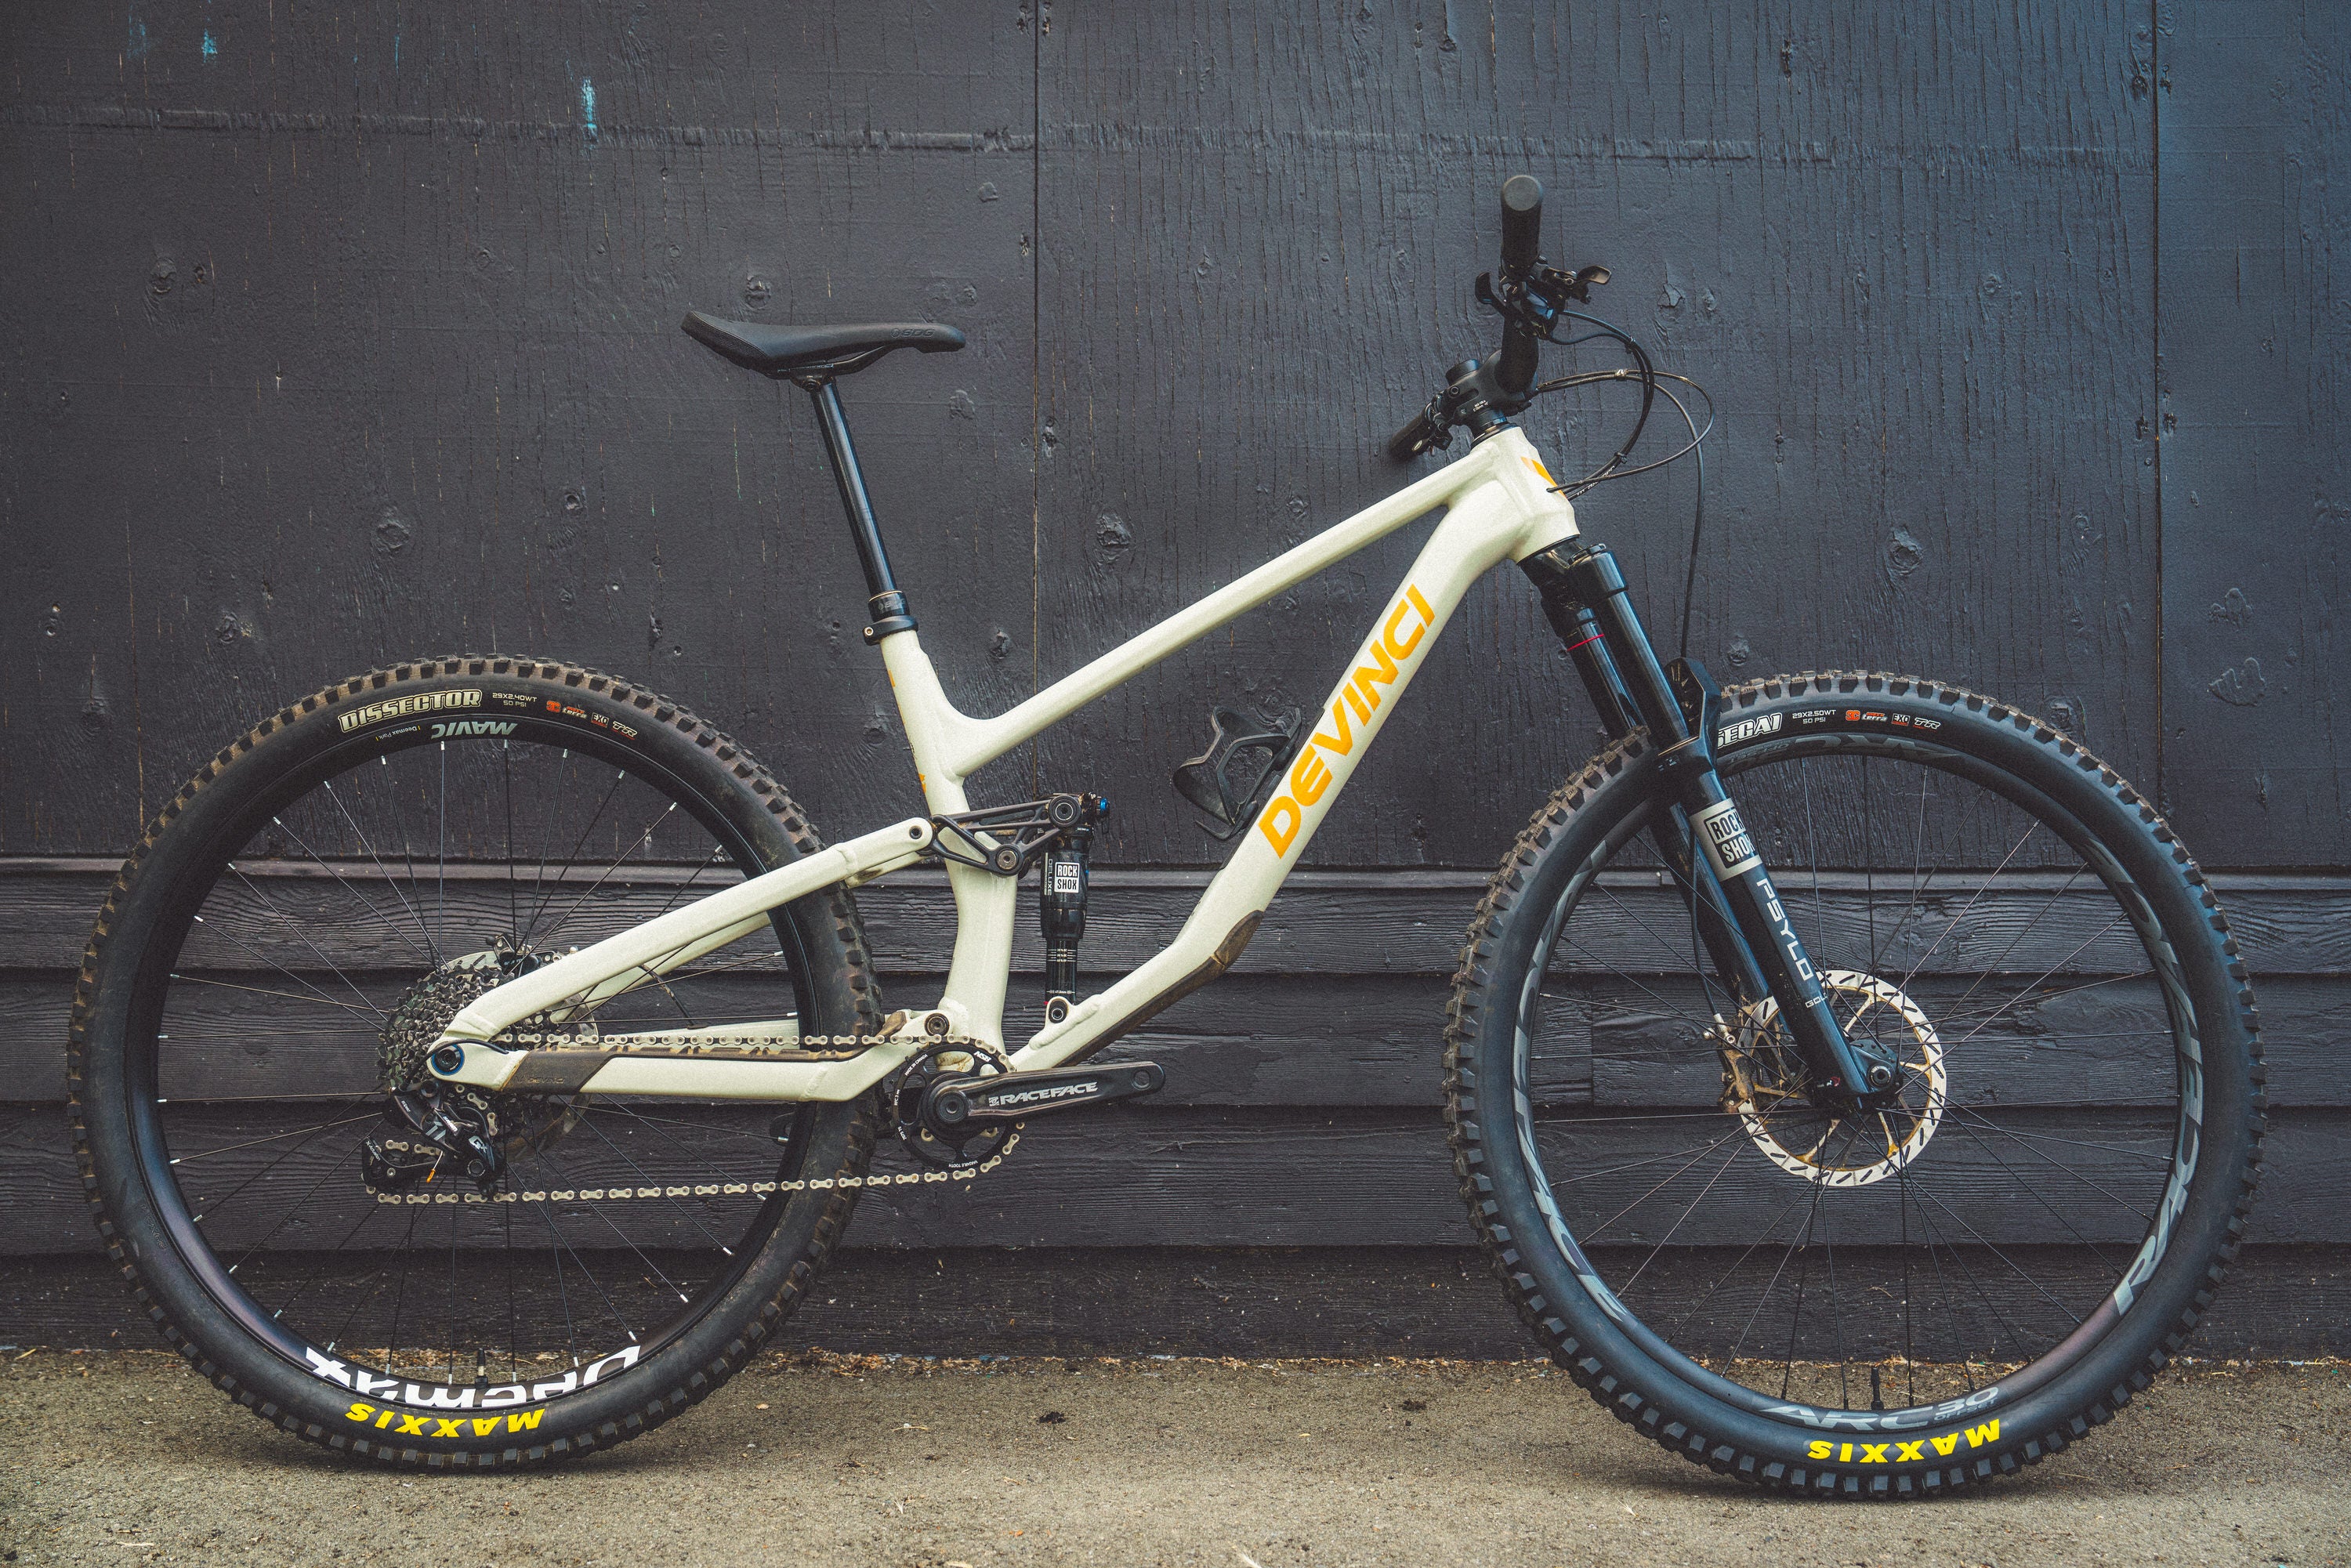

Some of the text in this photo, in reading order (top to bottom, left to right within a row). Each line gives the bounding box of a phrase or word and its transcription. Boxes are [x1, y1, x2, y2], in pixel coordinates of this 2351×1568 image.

[492, 692, 538, 702] 29X2.40WT
[338, 689, 482, 733] DISSECTOR
[592, 713, 609, 724] EXO
[1792, 709, 1836, 719] 29X2.50WT
[1846, 710, 1860, 721] 3C
[1893, 714, 1910, 722] EXO
[612, 721, 638, 737] TR
[1258, 584, 1435, 859] DEVINCI
[1914, 717, 1940, 730] TR
[392, 726, 418, 736] Deemax
[431, 721, 518, 739] MAVIC
[1710, 810, 1745, 840] ROCK
[1057, 864, 1078, 877] ROCK
[1057, 878, 1078, 890] SHOX
[1756, 878, 1813, 981] PSYLO
[1805, 992, 1828, 1009] GOL
[1001, 1081, 1098, 1105] RACEFACE
[345, 1403, 545, 1438] MAXXIS
[1807, 1418, 2001, 1463] MAXXIS
